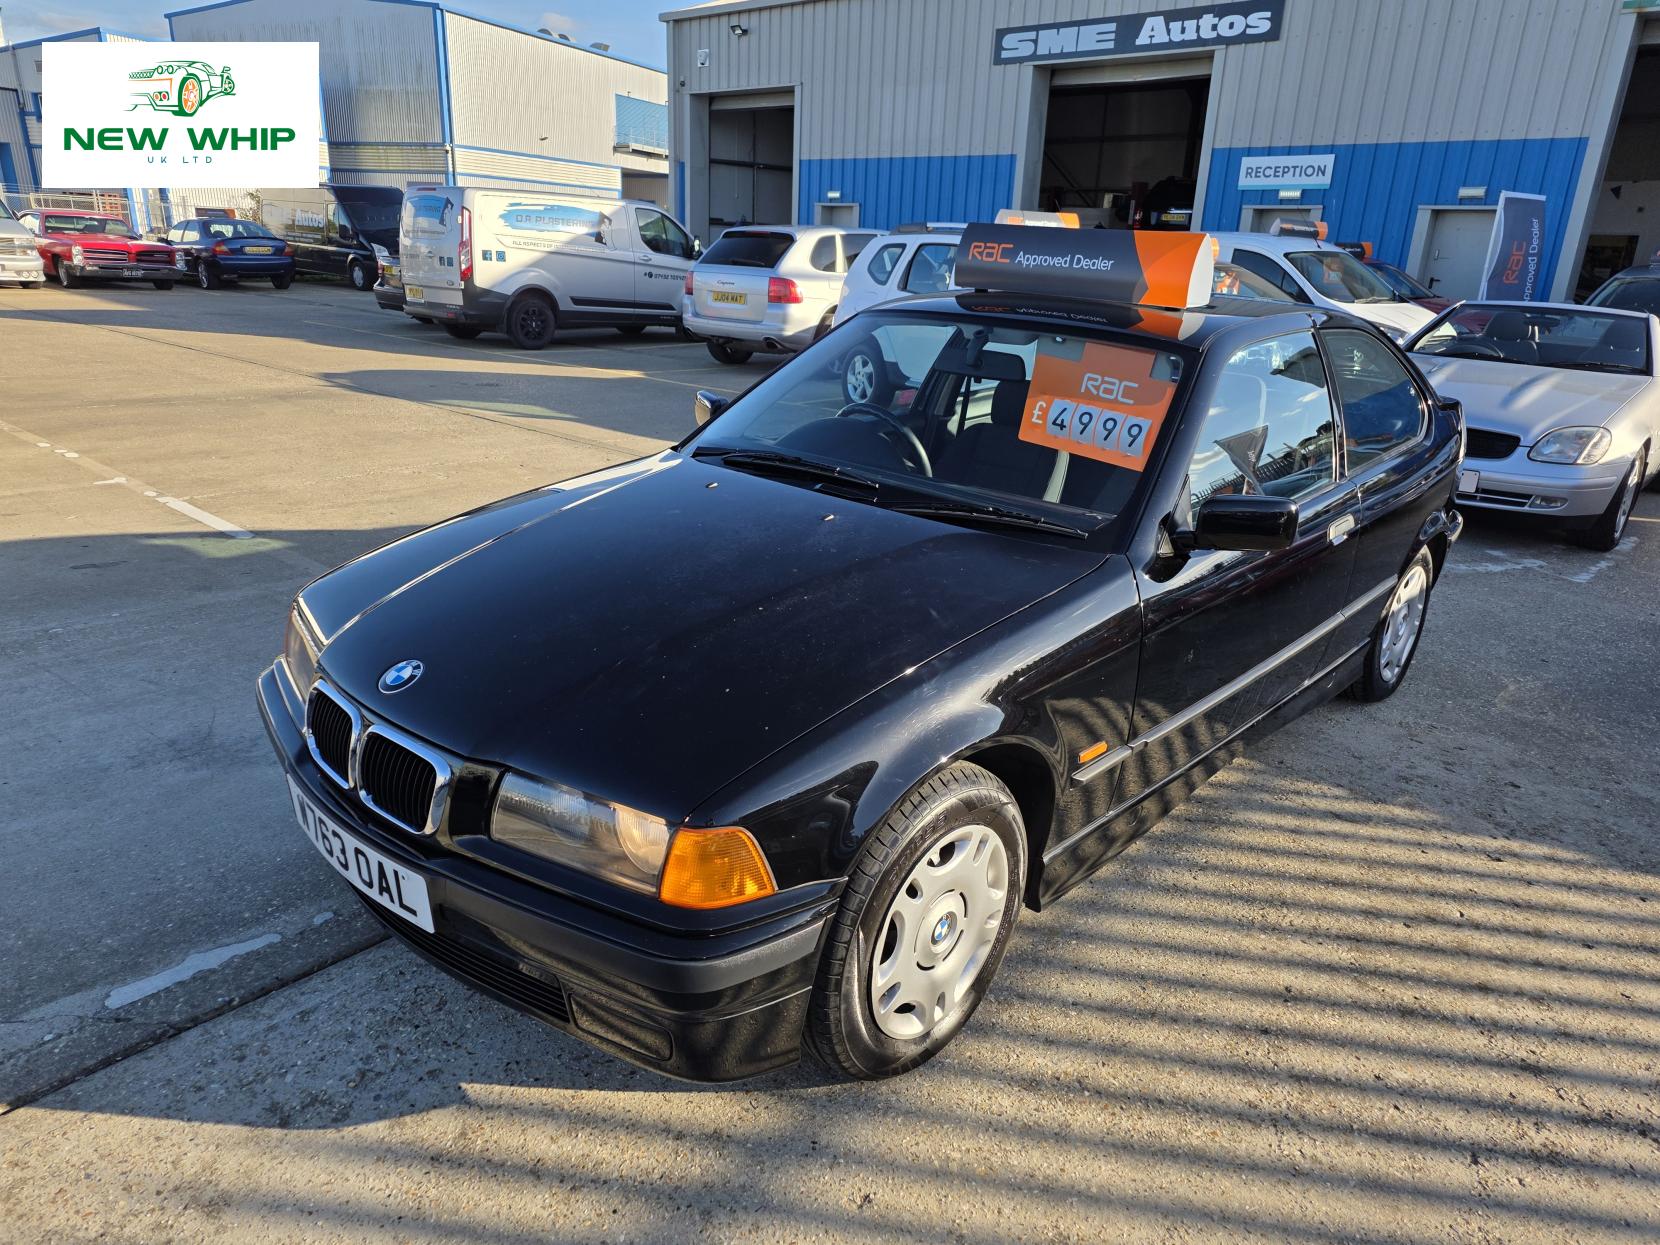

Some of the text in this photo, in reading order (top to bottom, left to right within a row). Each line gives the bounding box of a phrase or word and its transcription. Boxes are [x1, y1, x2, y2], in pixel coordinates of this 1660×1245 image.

[1001, 11, 1272, 59] SME Autos
[1245, 164, 1327, 179] RECEPTION
[295, 207, 324, 228] Autos
[1014, 250, 1071, 269] Approved
[1072, 254, 1115, 271] Dealer
[1523, 217, 1540, 302] pproved Dealer
[353, 846, 418, 918] OAL
